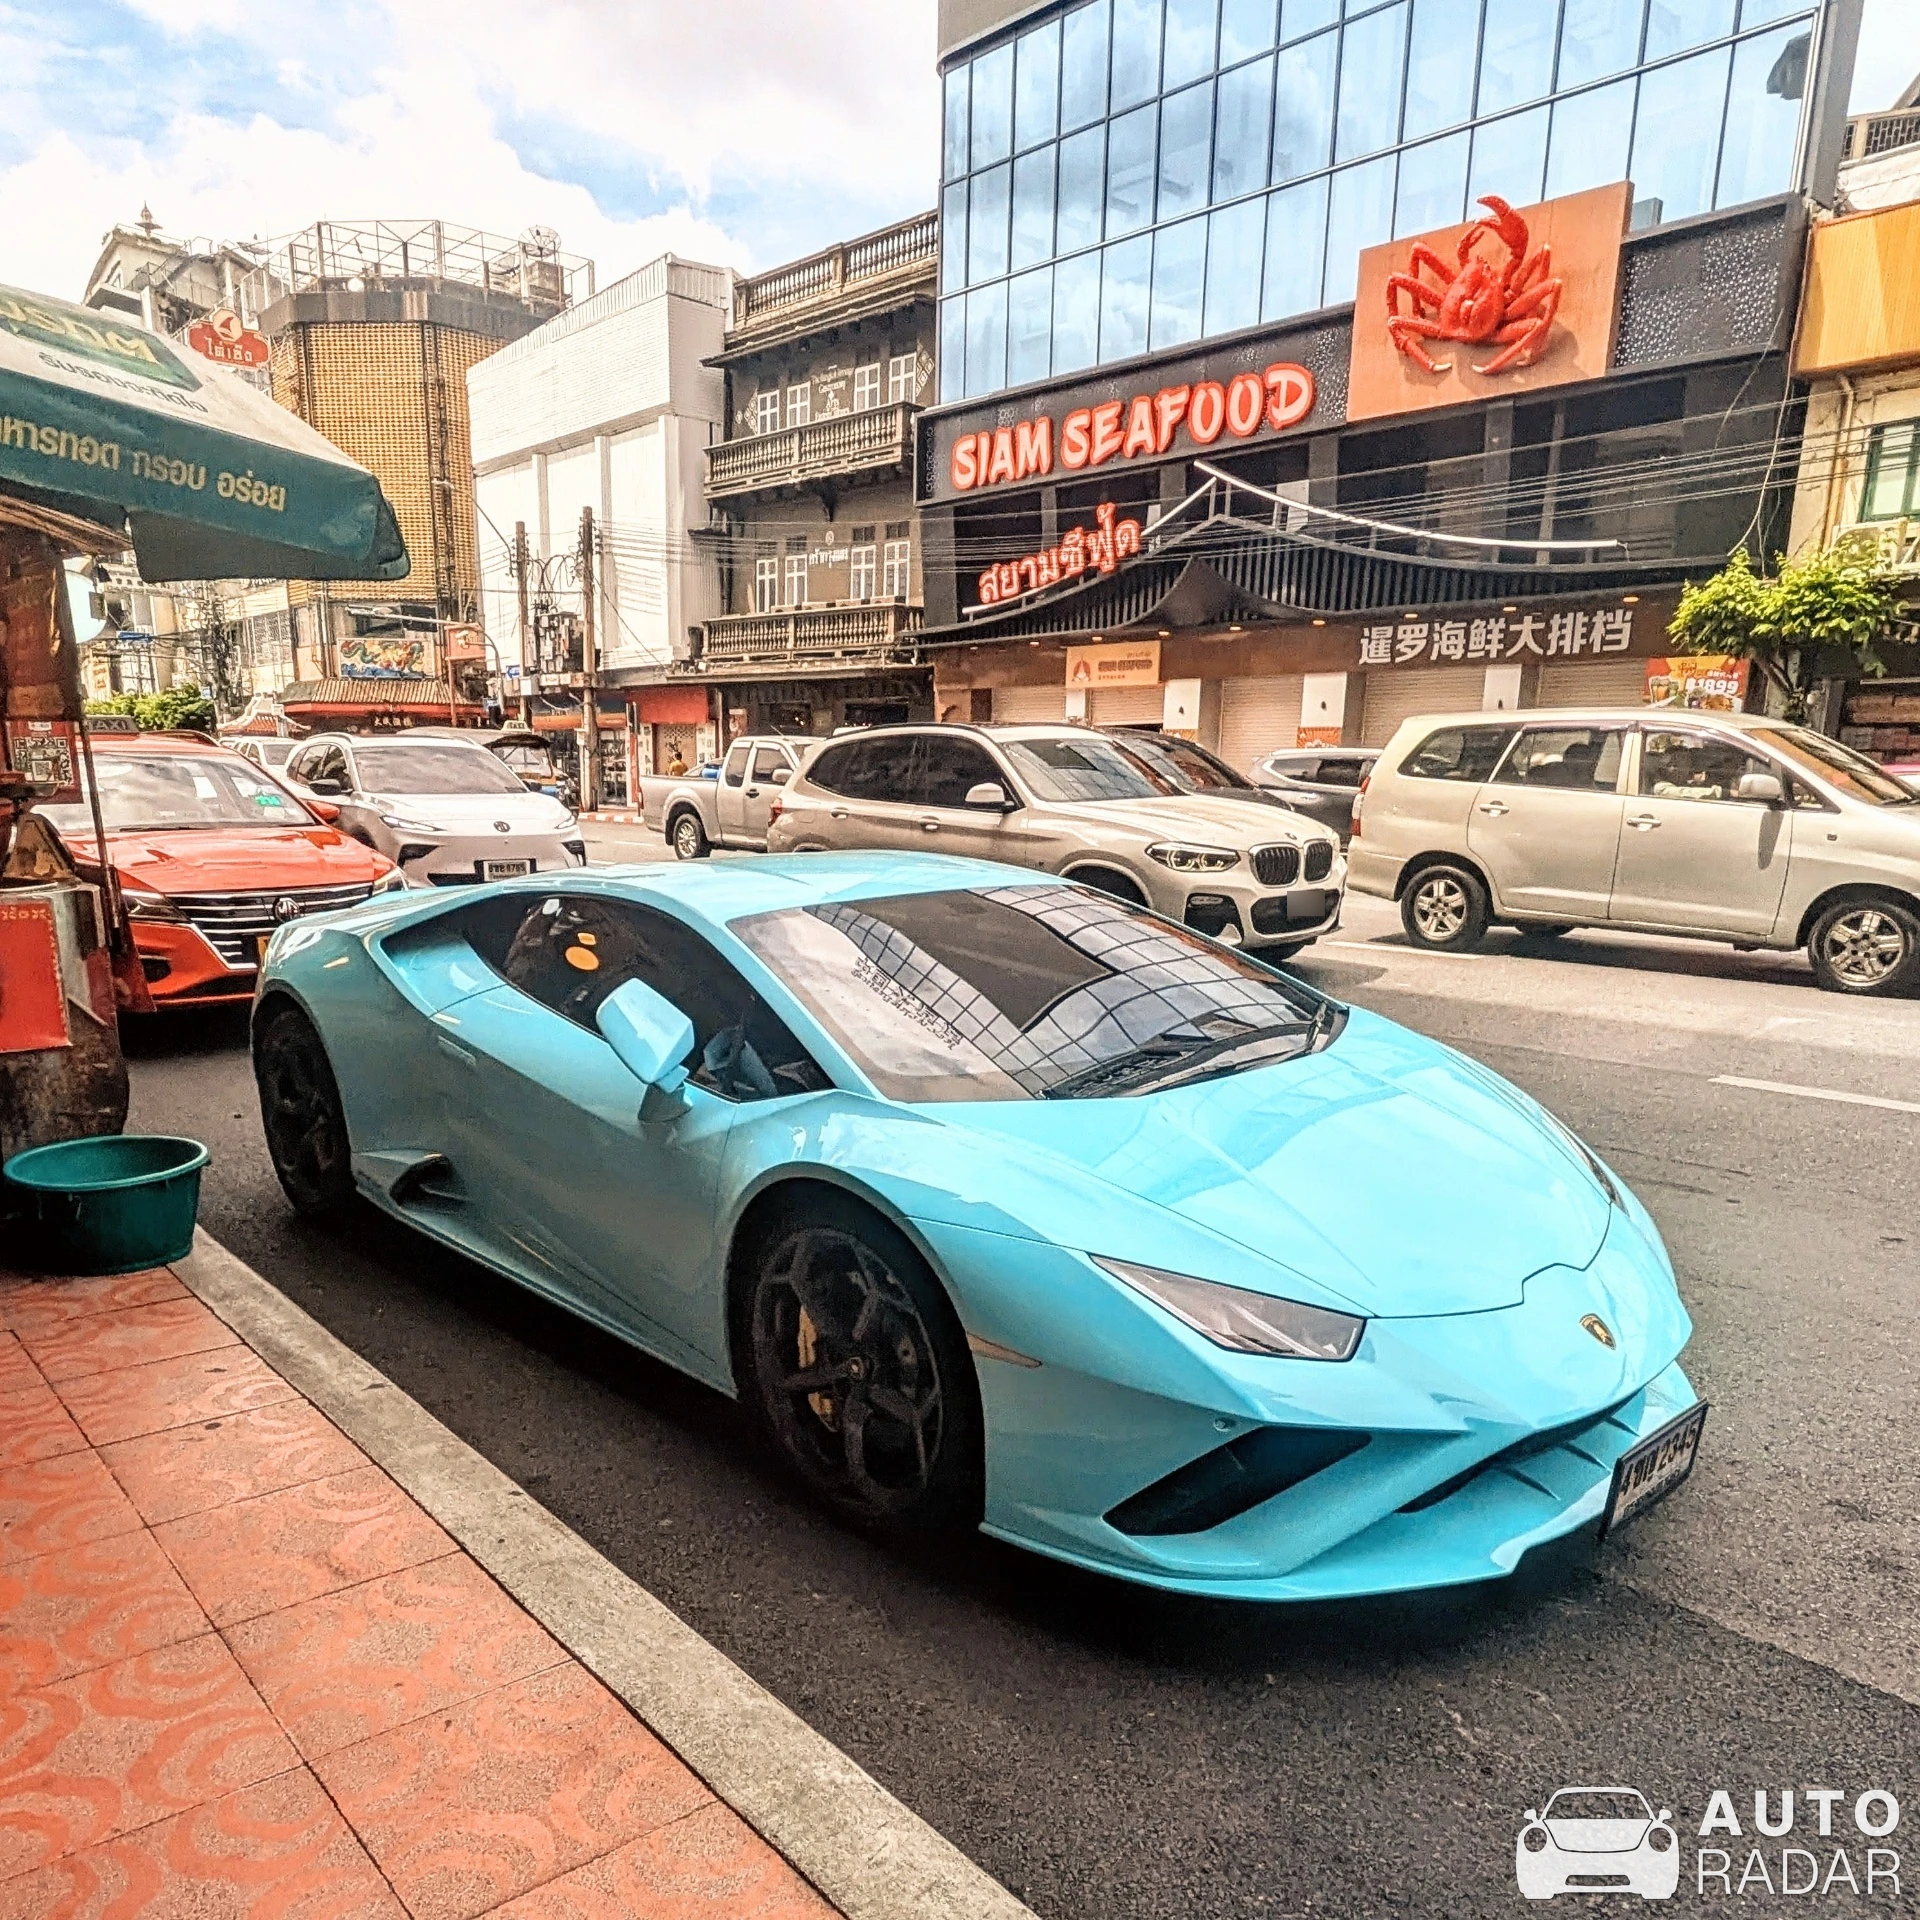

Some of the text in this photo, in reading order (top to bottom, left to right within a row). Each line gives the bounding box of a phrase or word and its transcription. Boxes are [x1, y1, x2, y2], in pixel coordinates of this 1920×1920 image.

[0, 415, 287, 512] หารทอด กรอบ อร่อย
[951, 361, 1315, 490] SIAM SEAFOOD
[978, 502, 1142, 604] สยามซีฟู้ด
[1359, 608, 1633, 665] 暹罗海鲜大排档
[1657, 1418, 1700, 1472] 2345
